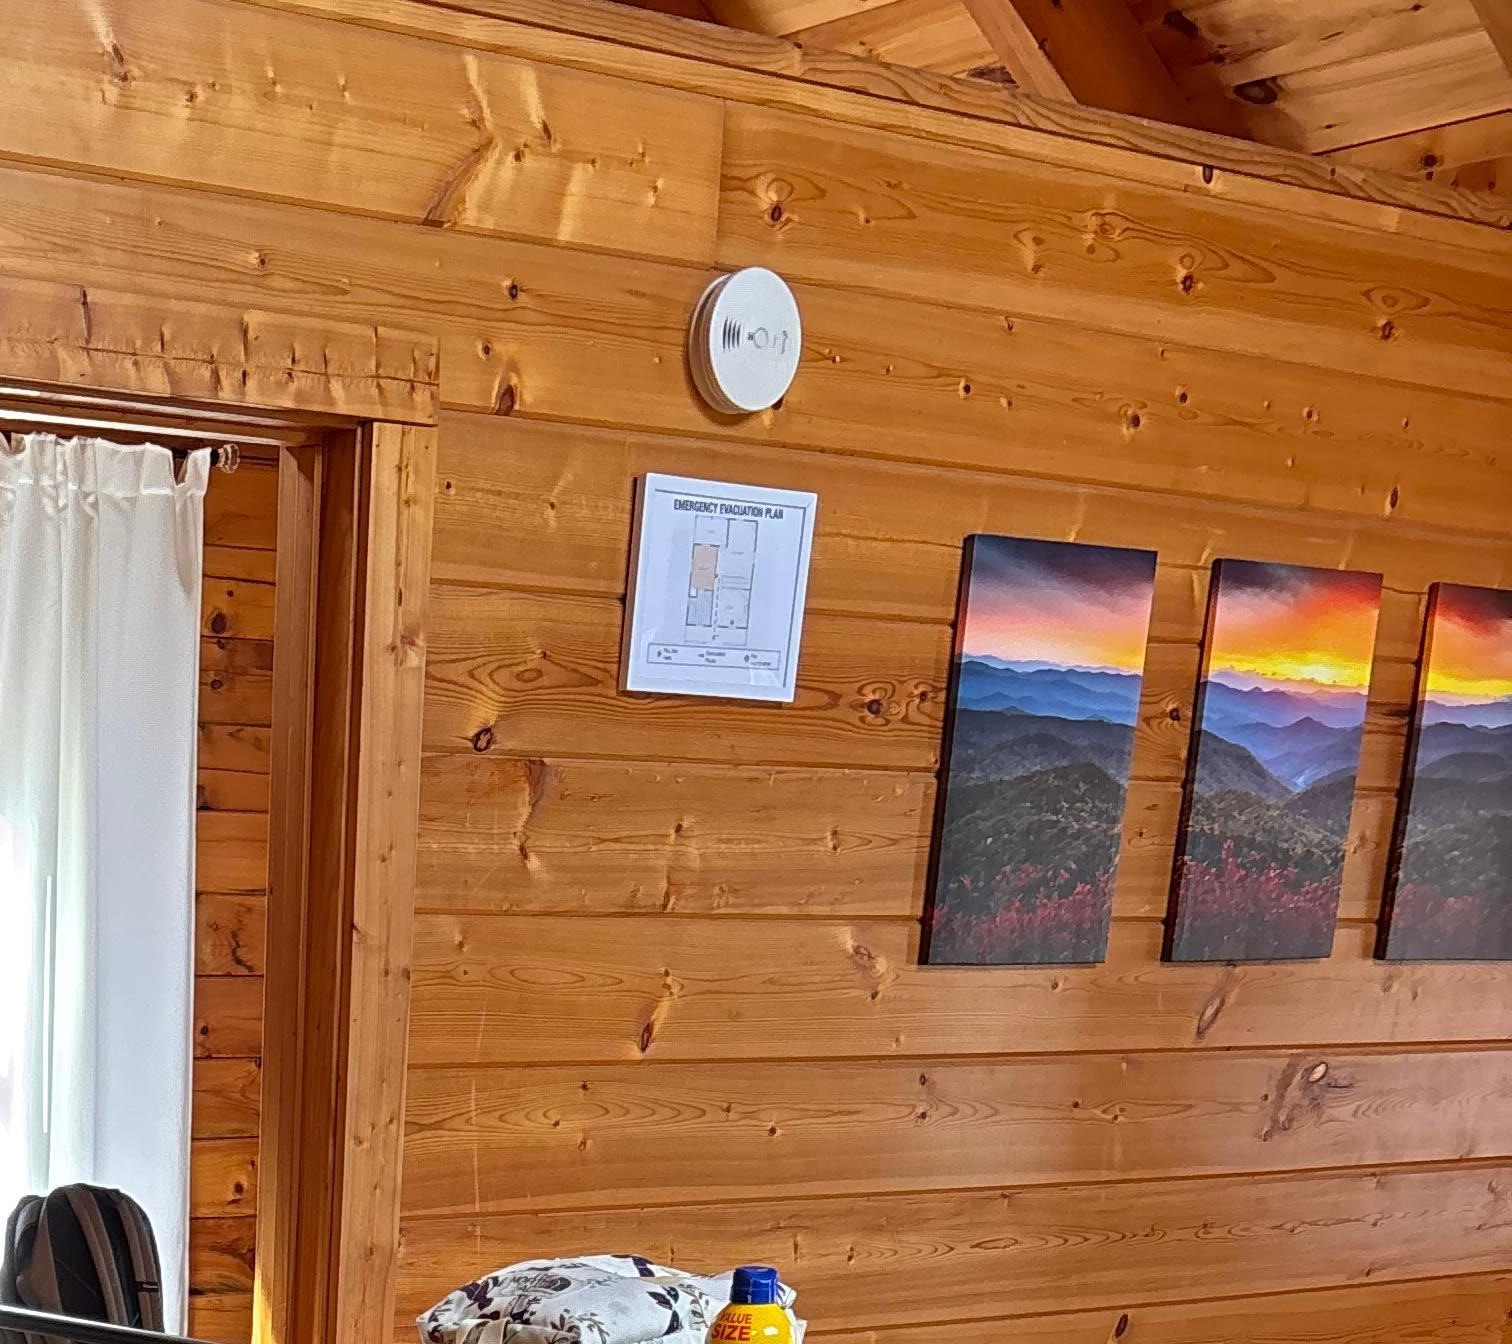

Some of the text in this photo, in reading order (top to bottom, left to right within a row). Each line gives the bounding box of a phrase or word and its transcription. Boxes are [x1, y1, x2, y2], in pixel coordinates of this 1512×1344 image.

[673, 498, 784, 519] EMERGENCY EVACUATION PLAN
[719, 1312, 754, 1325] VALUE
[711, 1323, 753, 1342] SIZE
